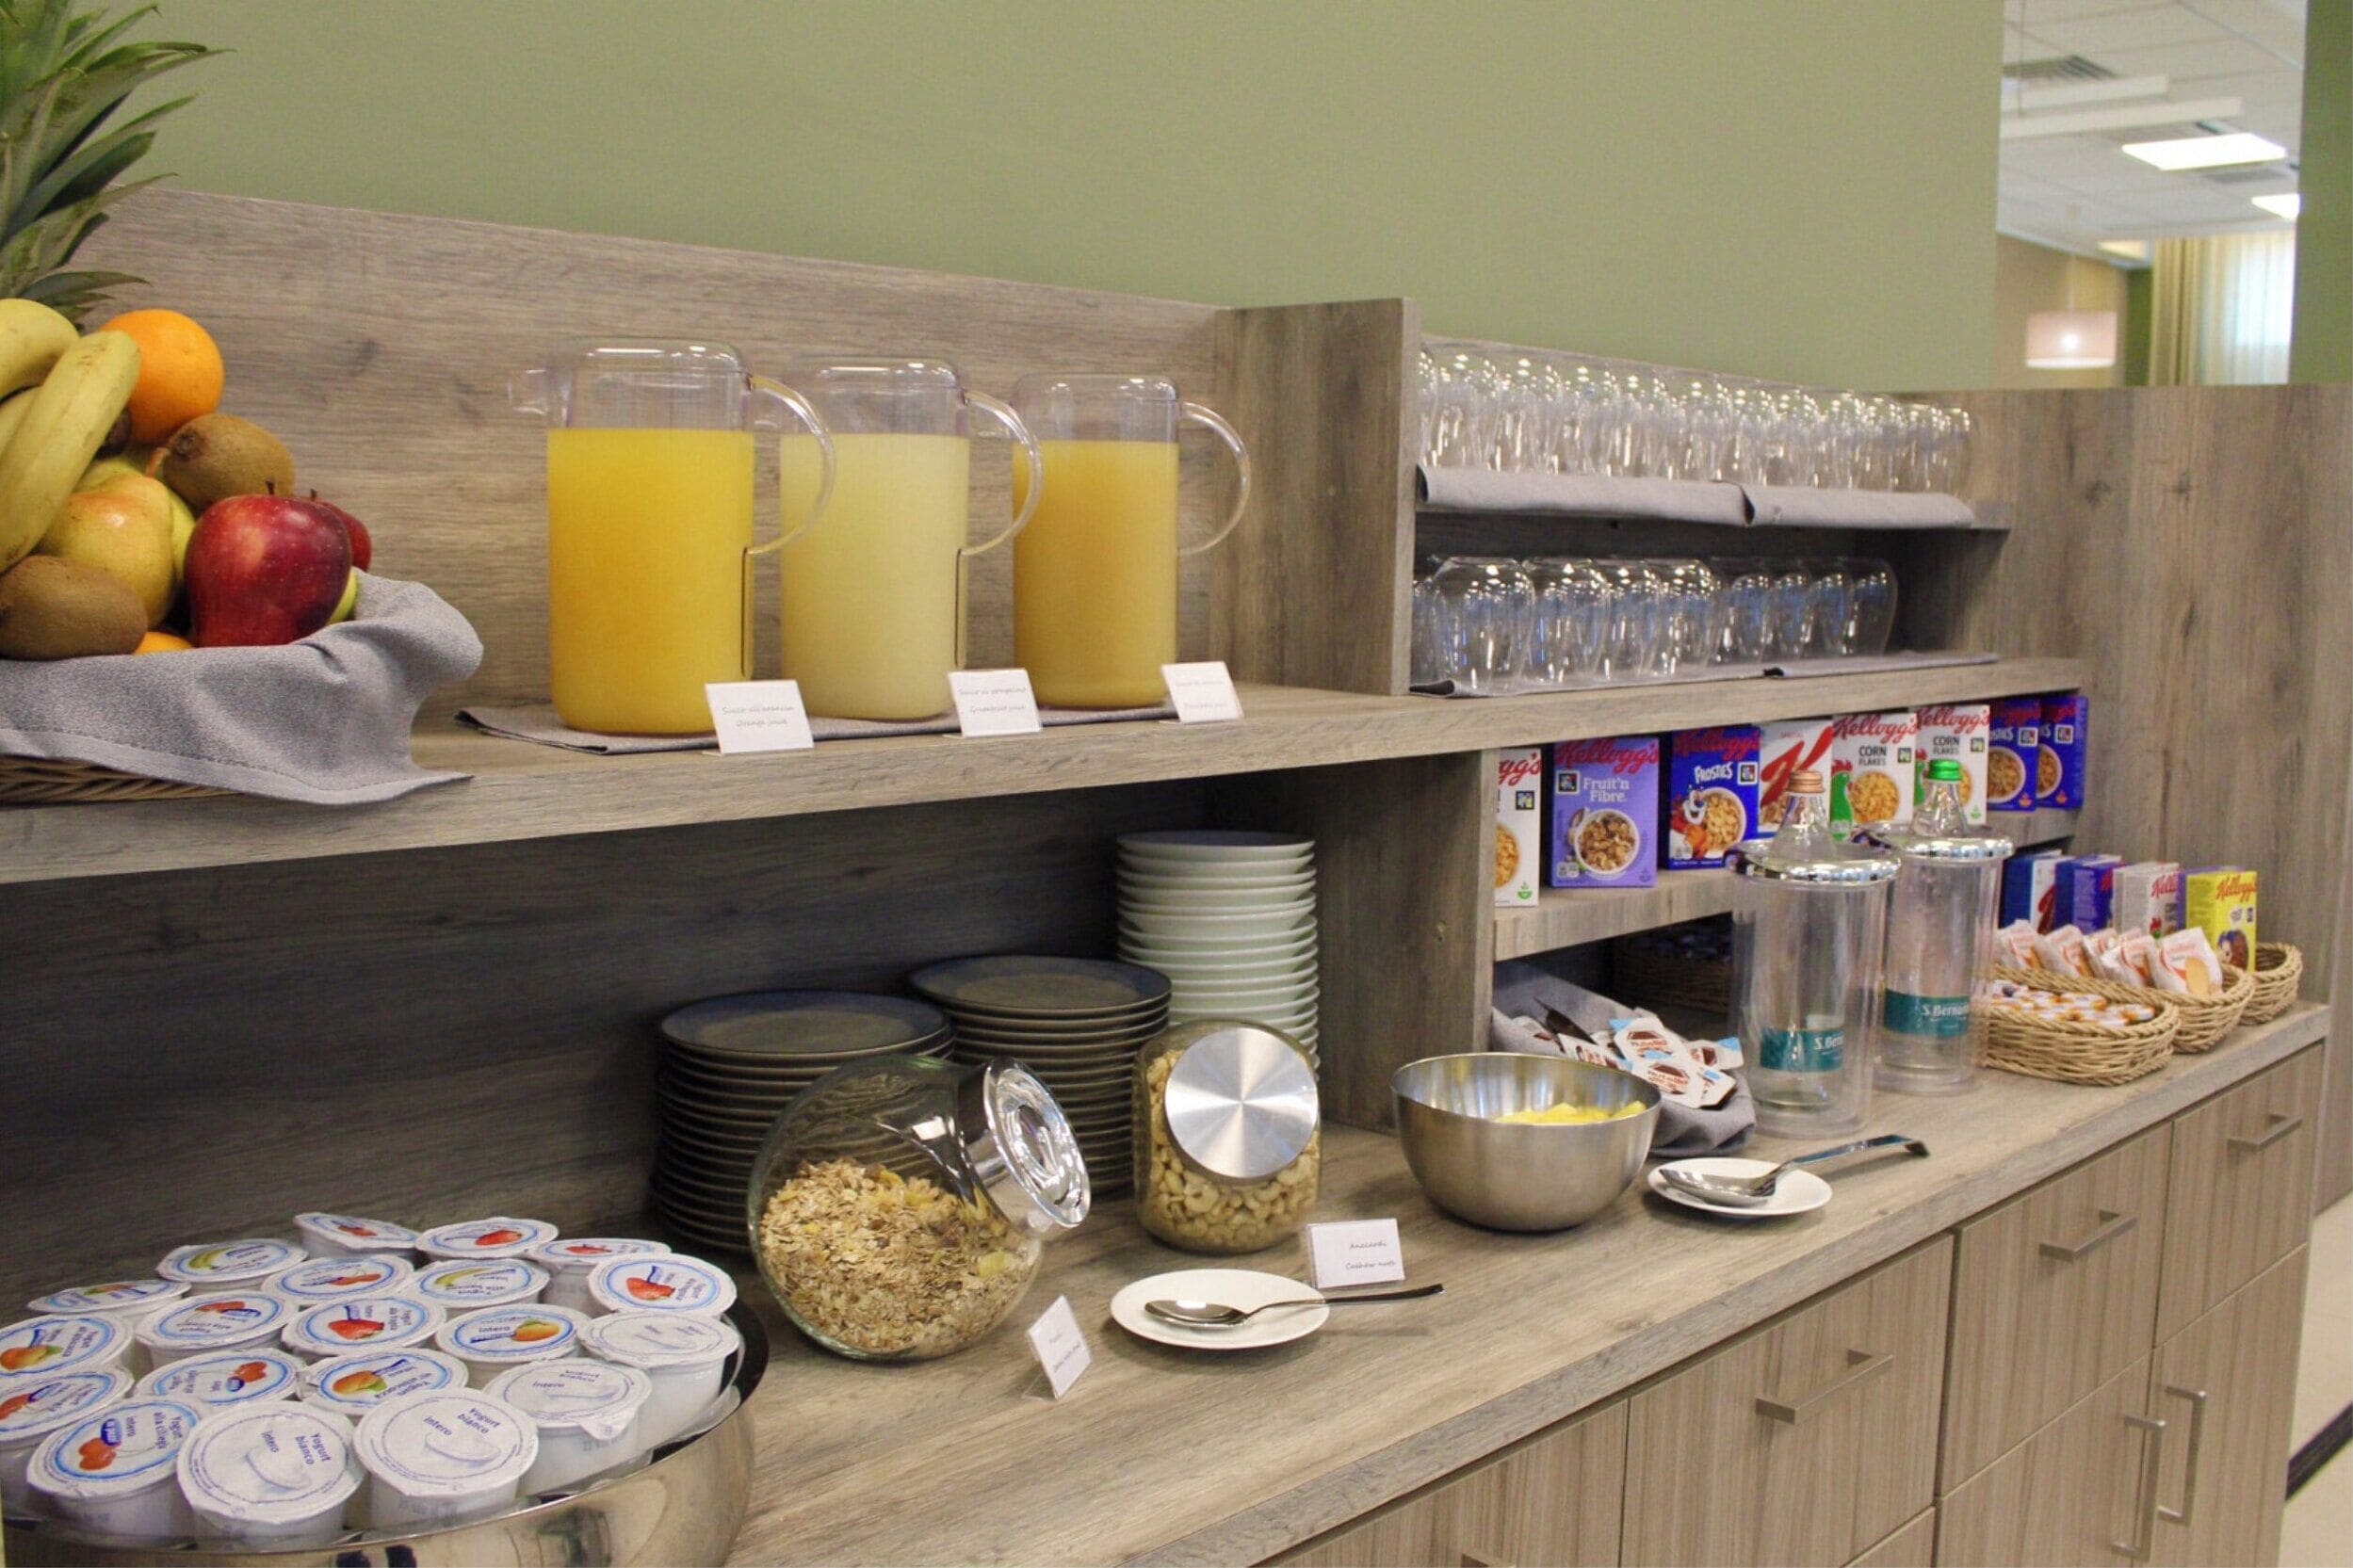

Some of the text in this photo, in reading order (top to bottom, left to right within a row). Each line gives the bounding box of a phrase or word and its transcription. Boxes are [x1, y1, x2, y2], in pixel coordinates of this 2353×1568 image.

[1831, 712, 1916, 744] Kellogg's
[1916, 703, 1989, 735] Kellogg's
[1858, 745, 1887, 757] CORN
[1934, 736, 1960, 746] CORN
[1553, 736, 1659, 775] Kellogg's
[1858, 757, 1886, 766] FLAKES
[1589, 791, 1627, 803] Fibre
[532, 1381, 565, 1389] intero
[423, 1415, 453, 1437] intero
[458, 1414, 490, 1435] bianco
[469, 1407, 502, 1430] Yogurt
[261, 1430, 280, 1453] intero
[295, 1434, 315, 1465] bianco
[312, 1431, 333, 1463] Yogurt
